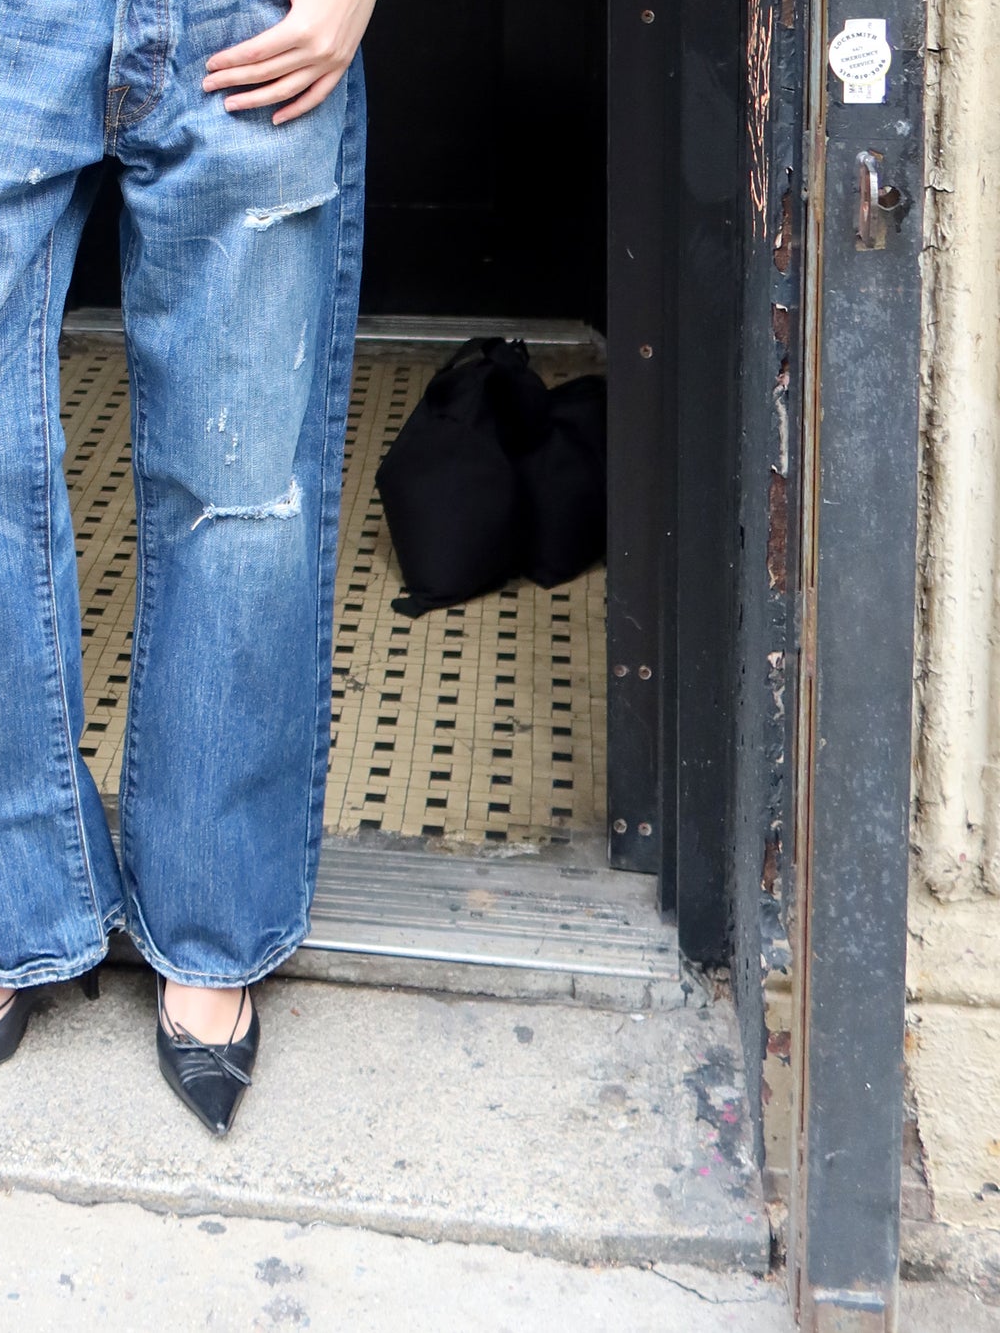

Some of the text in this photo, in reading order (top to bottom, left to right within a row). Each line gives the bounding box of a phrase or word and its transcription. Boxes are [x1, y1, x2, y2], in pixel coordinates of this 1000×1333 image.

[834, 32, 877, 50] LOCKSMITH
[841, 50, 878, 63] EMERGENCY
[849, 59, 875, 69] SERVICE
